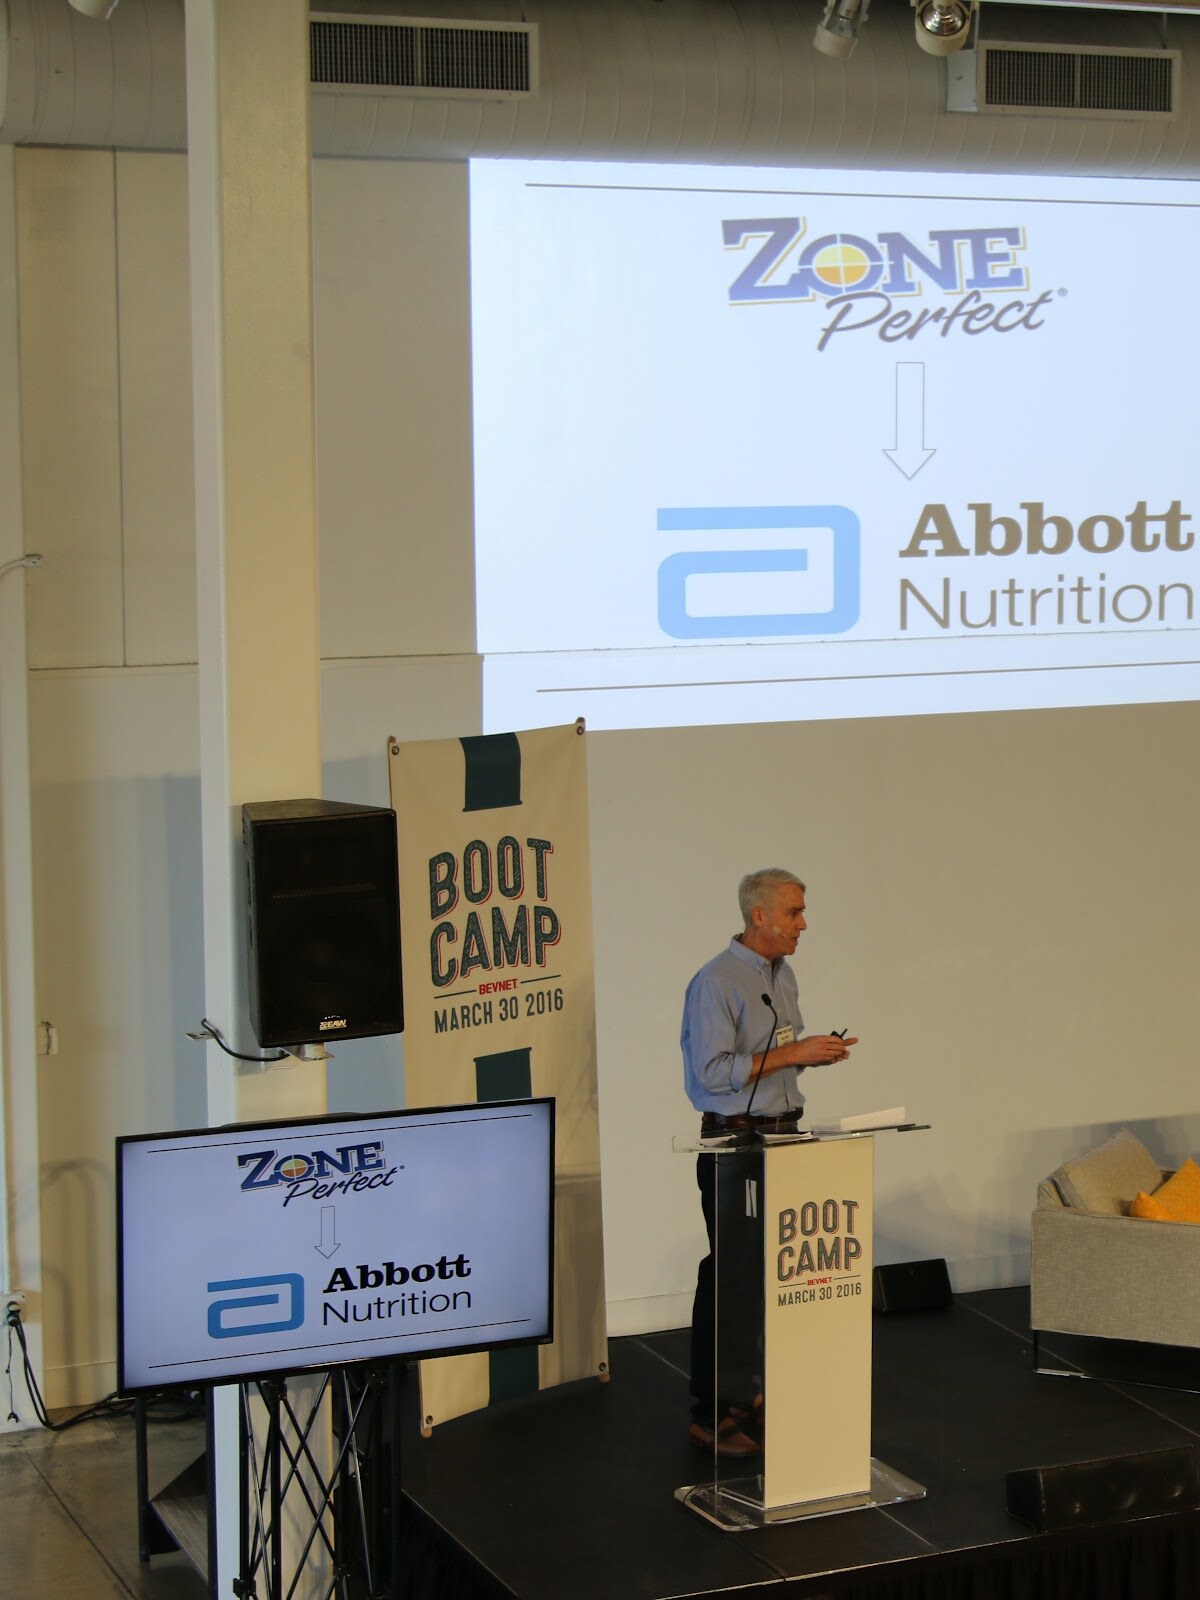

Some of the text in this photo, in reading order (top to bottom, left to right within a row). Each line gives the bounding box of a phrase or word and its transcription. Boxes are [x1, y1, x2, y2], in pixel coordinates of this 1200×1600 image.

[721, 216, 1029, 306] ZONE
[817, 288, 1054, 352] Perfect
[899, 500, 1195, 558] Abbott
[899, 572, 1195, 631] Nutrition
[429, 836, 554, 921] BOOT
[430, 905, 562, 988] CAMP
[479, 979, 518, 995] BEVNET
[434, 988, 563, 1033] MARCH 30 2016
[237, 1141, 386, 1192] ZONE
[283, 1166, 398, 1207] Perfect
[779, 1199, 859, 1246] BOOT
[322, 1254, 471, 1293] Abbott
[777, 1237, 862, 1281] CAMP
[807, 1277, 833, 1286] BEVNET
[323, 1288, 471, 1326] Nutrition
[778, 1283, 862, 1307] MARCH 30 2016
